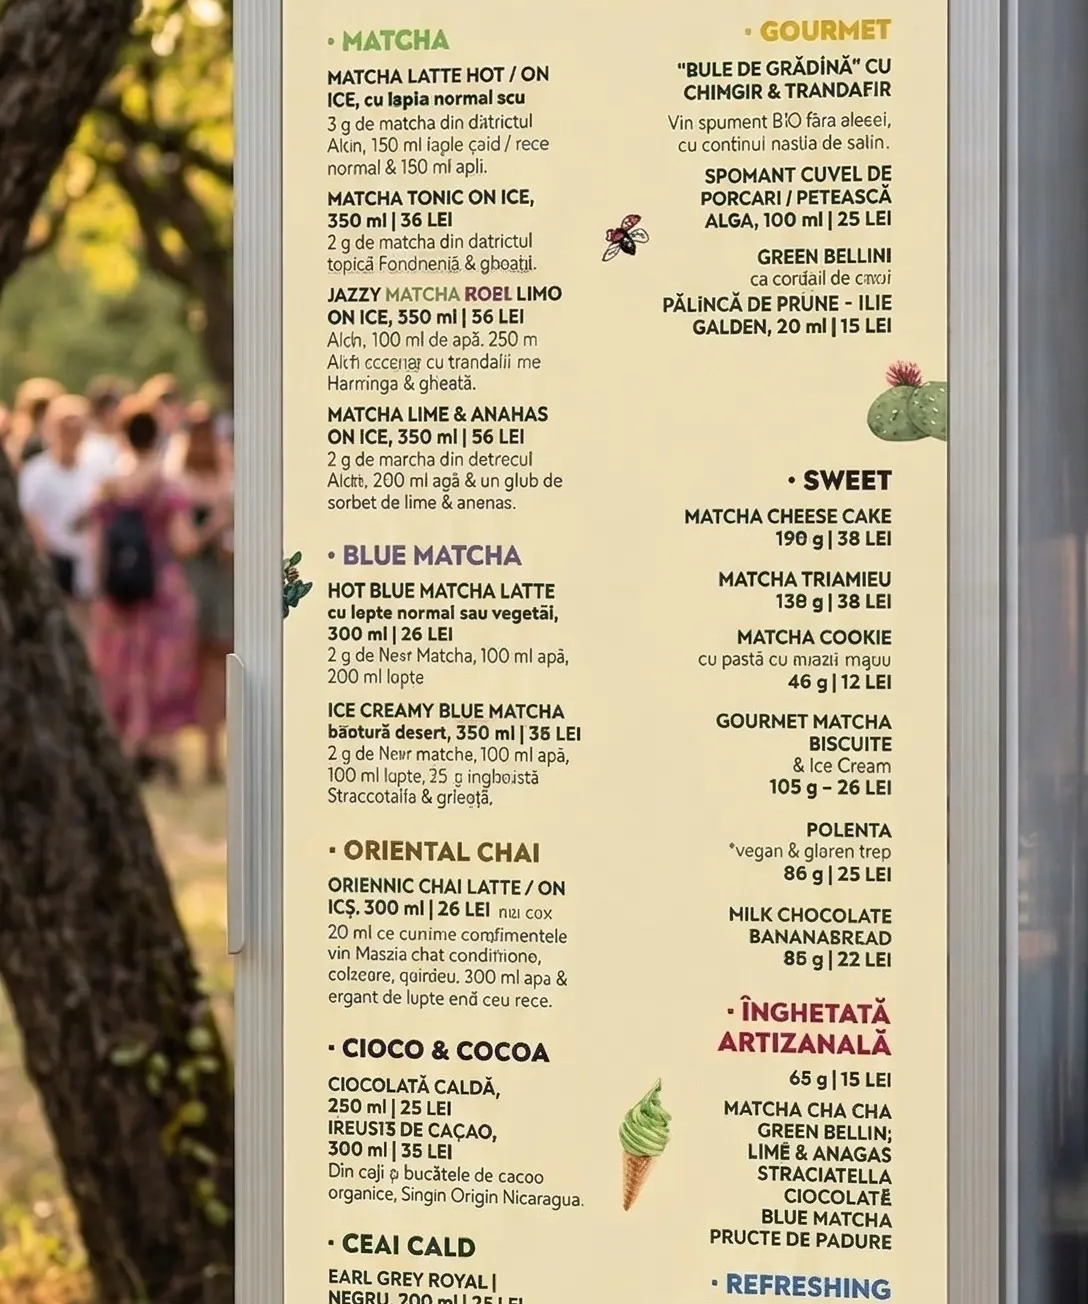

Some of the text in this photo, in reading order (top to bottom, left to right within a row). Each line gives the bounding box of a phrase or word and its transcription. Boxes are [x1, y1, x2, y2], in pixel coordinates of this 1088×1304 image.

[342, 28, 450, 52] MATCHA
[759, 18, 892, 42] GOURMET
[327, 65, 550, 86] MATCHA LATTE HOT ON
[767, 82, 782, 100] &
[783, 80, 892, 99] TRANDAFIR
[327, 113, 465, 136] 3 g de matcha din
[327, 188, 535, 208] MATCHA TONIC ON ICE,
[327, 211, 453, 229] 350 ml 36 LEI
[327, 233, 337, 251] 2
[340, 238, 351, 255] g
[354, 233, 375, 251] de
[379, 233, 436, 250] matcha
[439, 232, 464, 250] din
[757, 247, 892, 266] GREEN BELLINI
[327, 405, 549, 423] MATCHA LIME & ANAHAS
[803, 469, 893, 492] SWEET
[327, 493, 378, 510] sorbet
[380, 493, 401, 510] de
[404, 493, 437, 510] lime
[441, 493, 454, 510] &
[684, 507, 892, 525] MATCHA CHEESE CAKE
[343, 544, 523, 567] BLUE MATCHA
[718, 570, 892, 588] MATCHA TRIAMIEU
[327, 581, 556, 600] HOT BLUE MATCHA LATTE
[327, 625, 453, 642] 300 ml 26 LEI
[737, 628, 892, 646] MATCHA COOKIE
[787, 673, 892, 694] 46 g 12 LEI
[328, 701, 566, 720] ICE CREAMY BLUE MATCHA
[809, 735, 893, 753] BISCUITE
[792, 756, 892, 774] & Ice Cream
[806, 821, 893, 839] POLENTA
[343, 839, 540, 864] ORIENTAL CHAI
[418, 877, 462, 895] CHAI
[467, 878, 522, 896] LATTE
[537, 879, 566, 897] ON
[341, 1037, 551, 1063] CIOCO & COCOA
[716, 1028, 893, 1057] ARTIZANALĂ
[327, 1074, 501, 1100] CIOCOLATĂ CALDĂ,
[789, 1069, 892, 1091] 65 g 15 LEI
[327, 1097, 452, 1117] 250 ml 25 LEI
[723, 1099, 893, 1120] MATCHA CHA CHA
[757, 1164, 893, 1185] STRACIATELLA
[327, 1185, 398, 1205] organice,
[450, 1186, 499, 1209] Origin
[502, 1188, 585, 1212] Nicaragua.
[761, 1208, 893, 1229] BLUE MATCHA
[341, 1232, 476, 1258] CEAI CALD
[328, 1268, 489, 1290] EARL GREY ROYAL
[726, 1272, 892, 1301] REFRESHING
